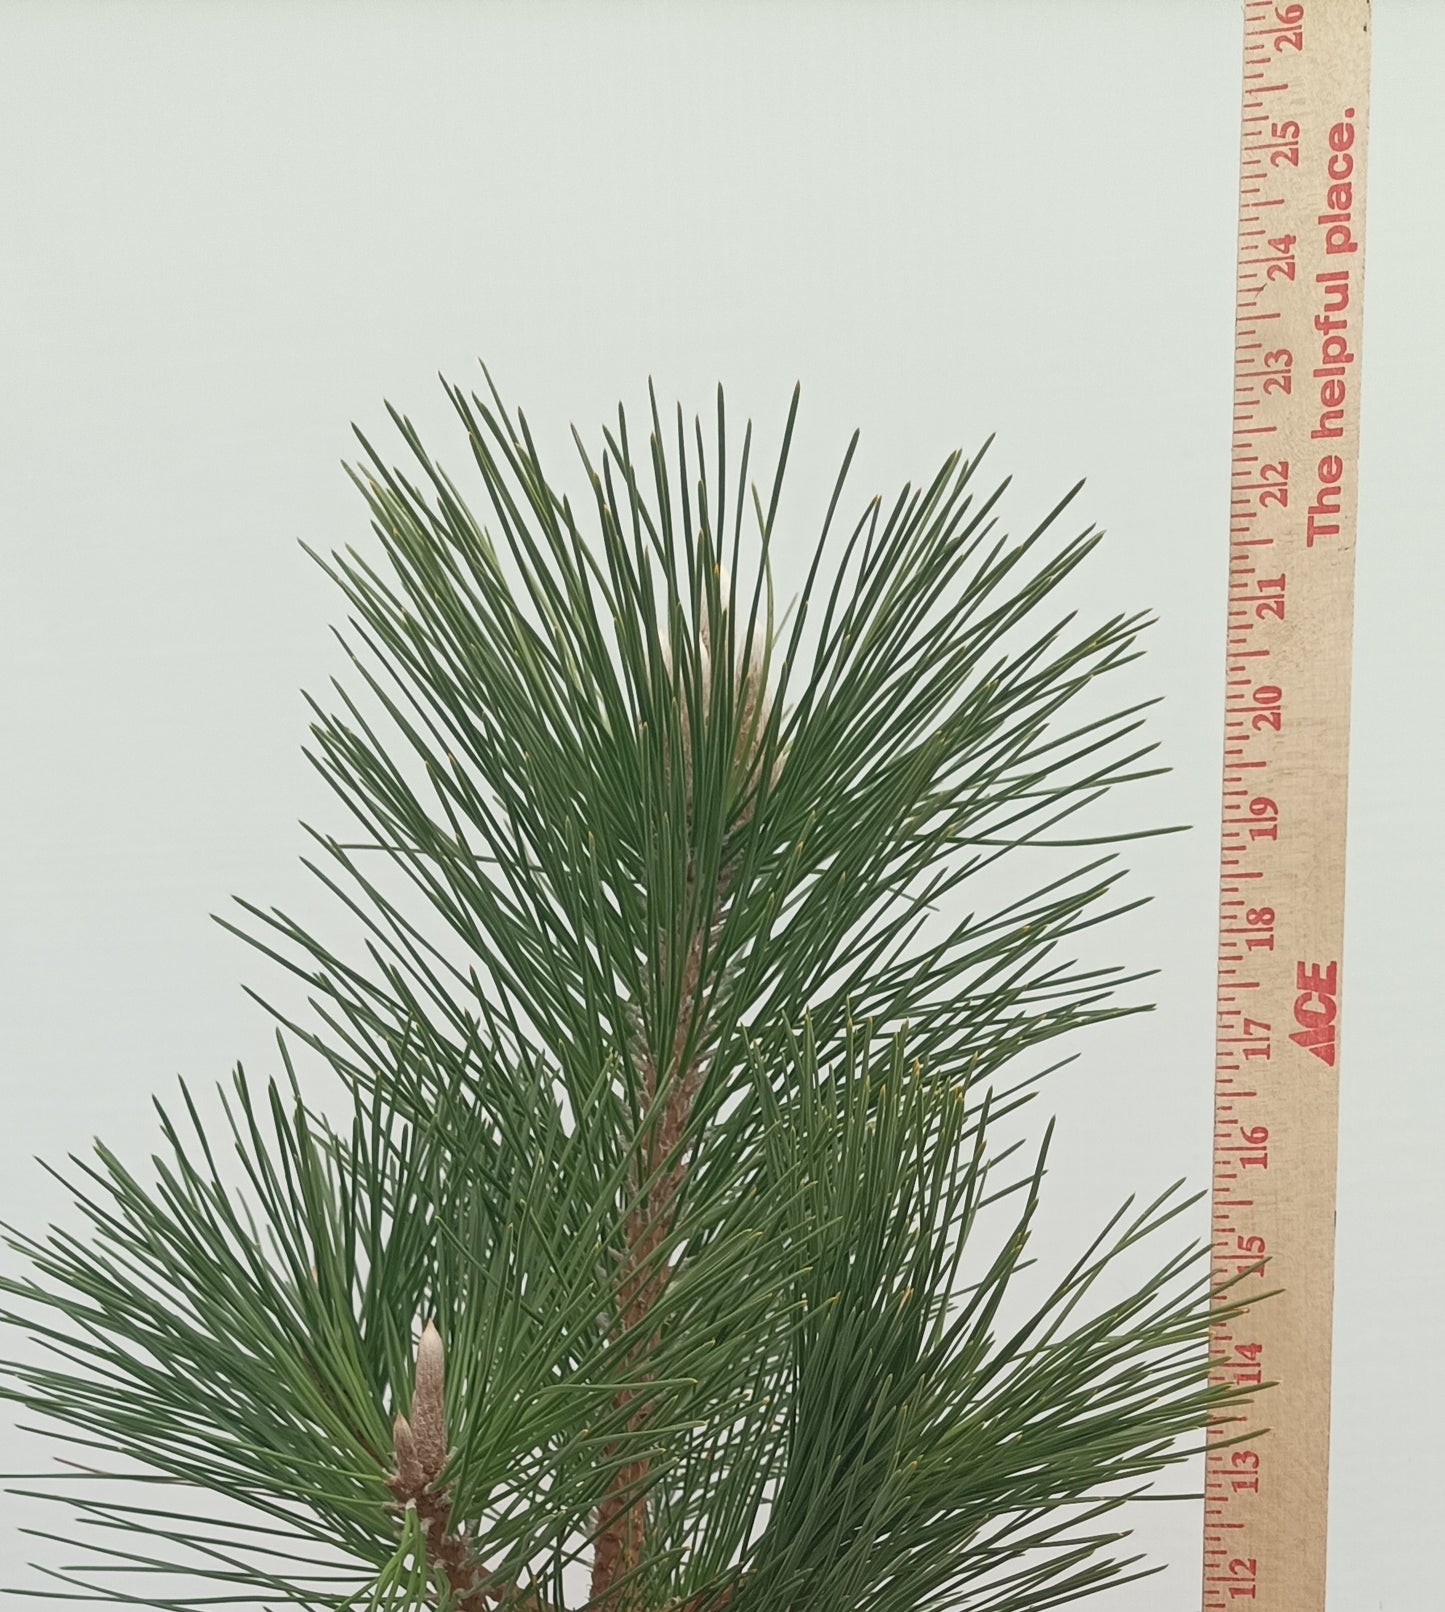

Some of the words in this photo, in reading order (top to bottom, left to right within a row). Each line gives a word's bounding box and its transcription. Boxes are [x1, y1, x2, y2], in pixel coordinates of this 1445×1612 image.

[1274, 4, 1304, 52] 26
[1270, 120, 1300, 167] 25
[1318, 107, 1358, 254] place.
[1267, 234, 1296, 281] 24
[1263, 348, 1293, 395] 23
[1311, 271, 1355, 439] helpful
[1259, 461, 1289, 508] 22
[1306, 455, 1344, 547] The
[1255, 573, 1286, 620] 21
[1252, 685, 1282, 732] 20
[1248, 796, 1279, 841] 19
[1245, 906, 1276, 952] 18
[1289, 960, 1337, 1066] ACE
[1242, 1017, 1272, 1060] 17
[1239, 1126, 1269, 1169] 16
[1236, 1235, 1266, 1277] 15
[1233, 1342, 1263, 1385] 14
[1231, 1450, 1260, 1493] 13
[1228, 1558, 1257, 1599] 12
